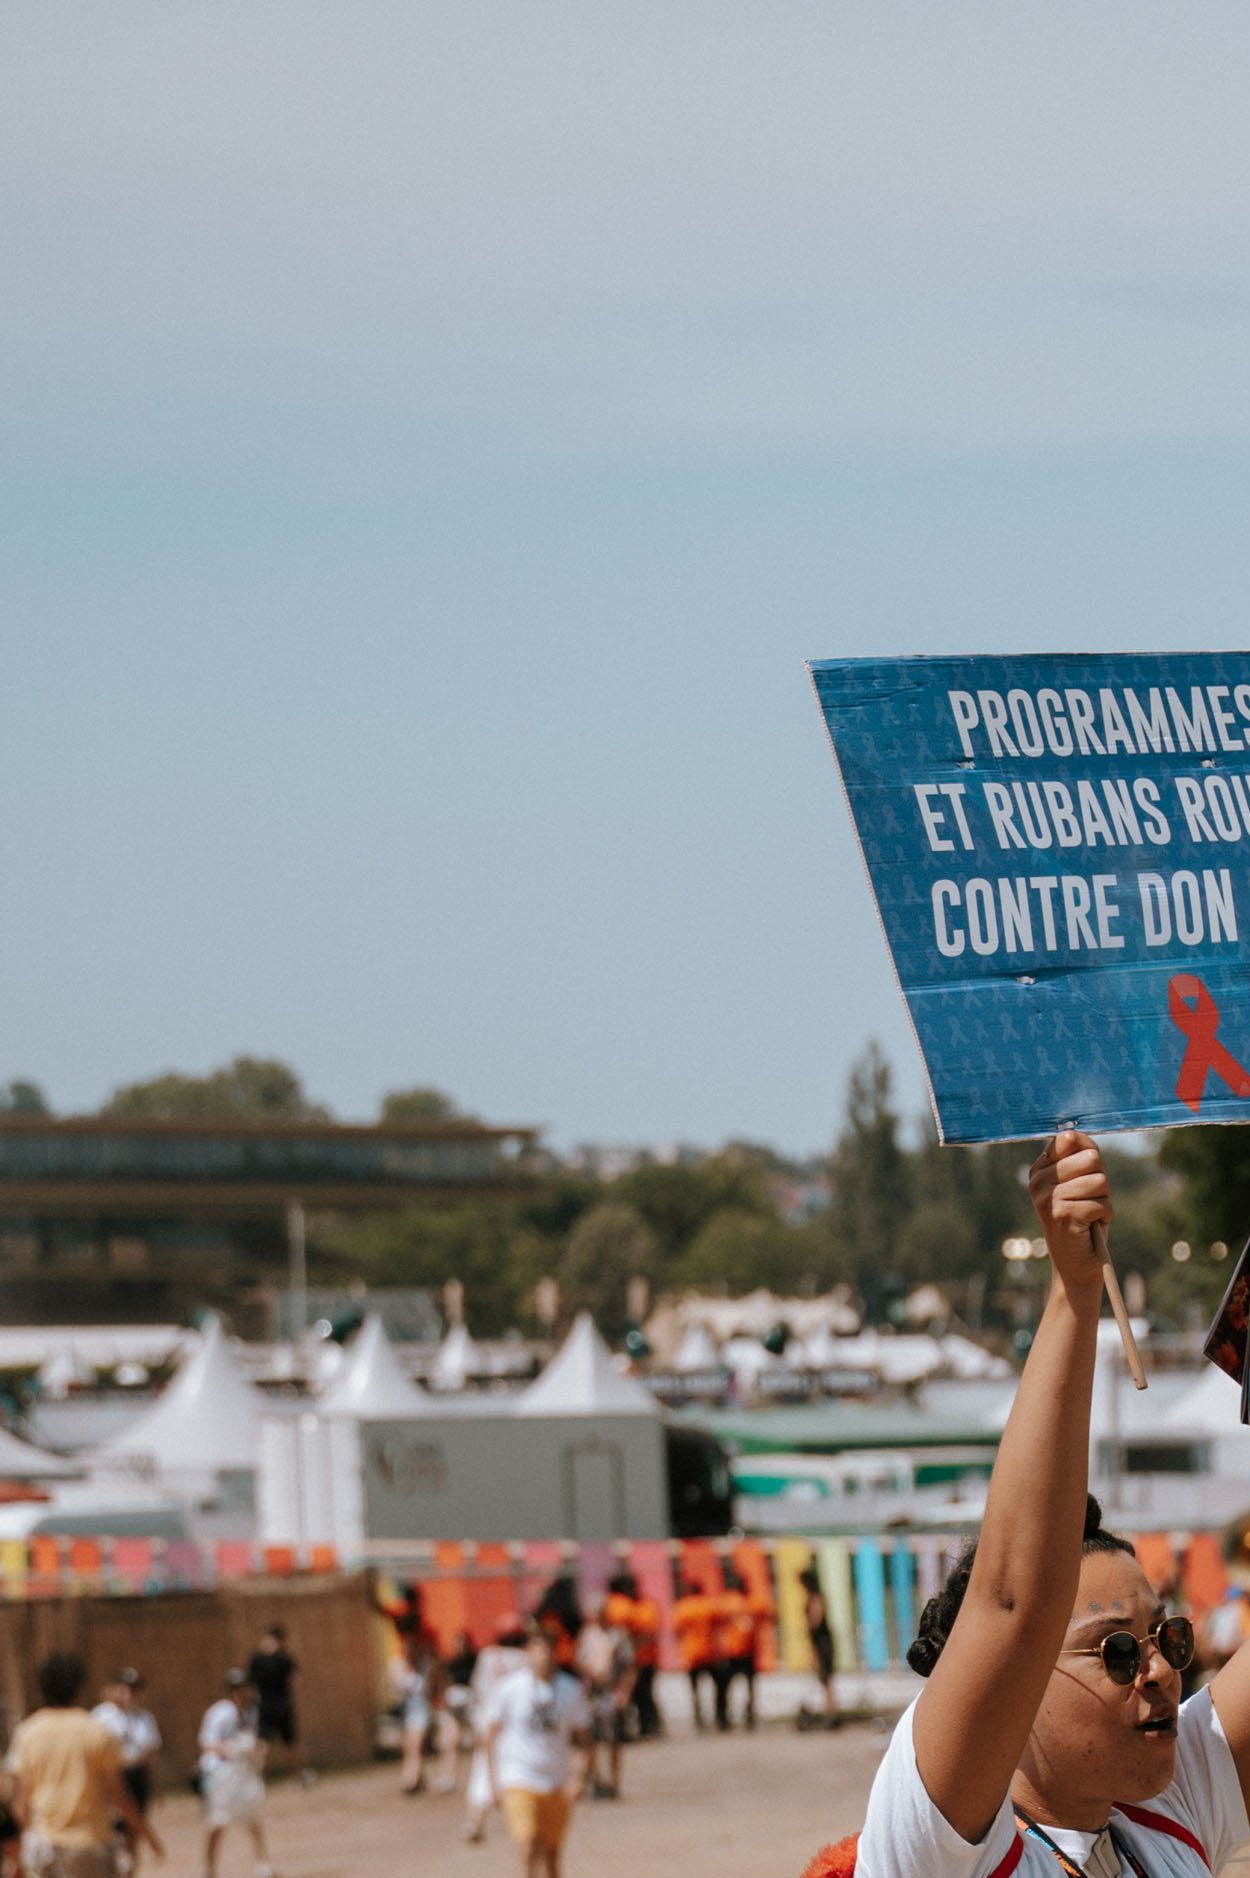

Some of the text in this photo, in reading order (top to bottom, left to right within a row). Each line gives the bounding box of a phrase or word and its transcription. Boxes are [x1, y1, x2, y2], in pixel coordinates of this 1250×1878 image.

[913, 781, 976, 852] ET
[980, 775, 1172, 850] RUBANS
[931, 873, 1126, 958] CONTRE
[1137, 868, 1239, 947] DON
